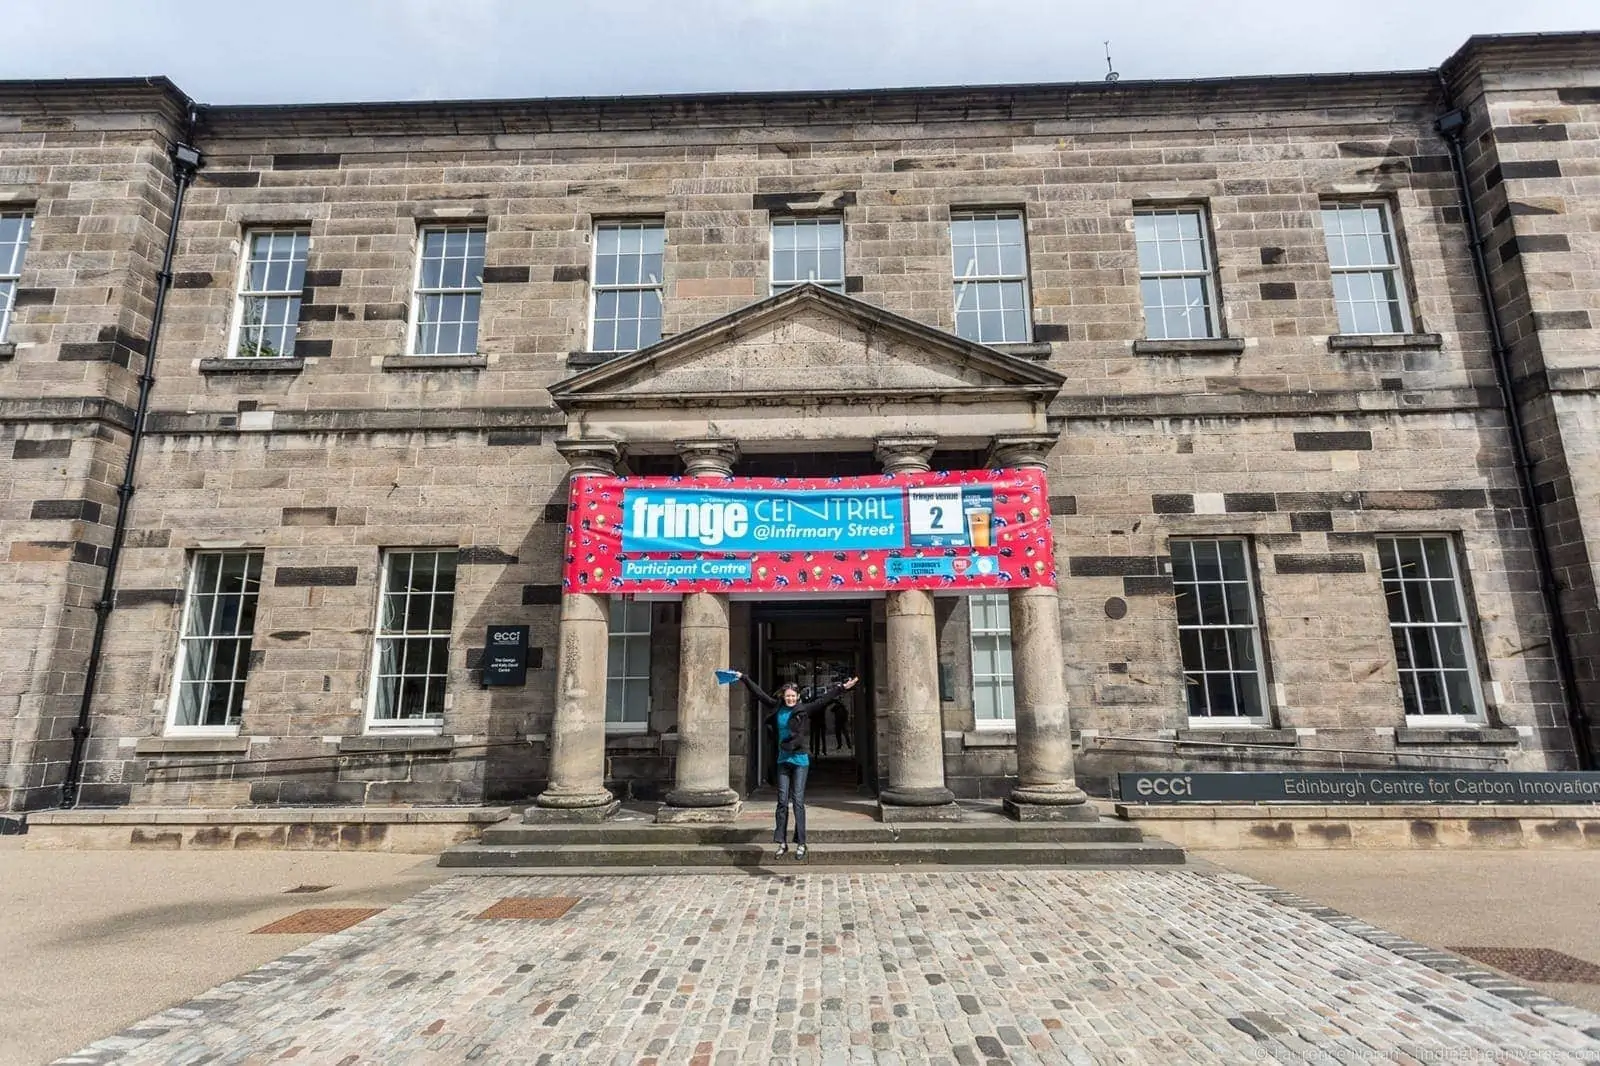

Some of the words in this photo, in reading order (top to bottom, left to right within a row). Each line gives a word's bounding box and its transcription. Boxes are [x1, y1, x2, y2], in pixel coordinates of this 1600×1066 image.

[754, 497, 894, 522] CENTRAL
[929, 506, 944, 529] 2
[632, 497, 748, 546] fringe
[753, 523, 843, 541] @Infirmary
[847, 523, 896, 537] Street
[626, 562, 698, 576] Participant
[701, 562, 746, 574] Centre
[494, 631, 520, 640] ecci
[1136, 776, 1193, 796] ecci
[1284, 778, 1366, 798] Edinburgh
[1370, 778, 1424, 795] Centre
[1428, 778, 1450, 794] for
[1454, 778, 1514, 795] Carbon
[1519, 779, 1600, 795] Innovation
